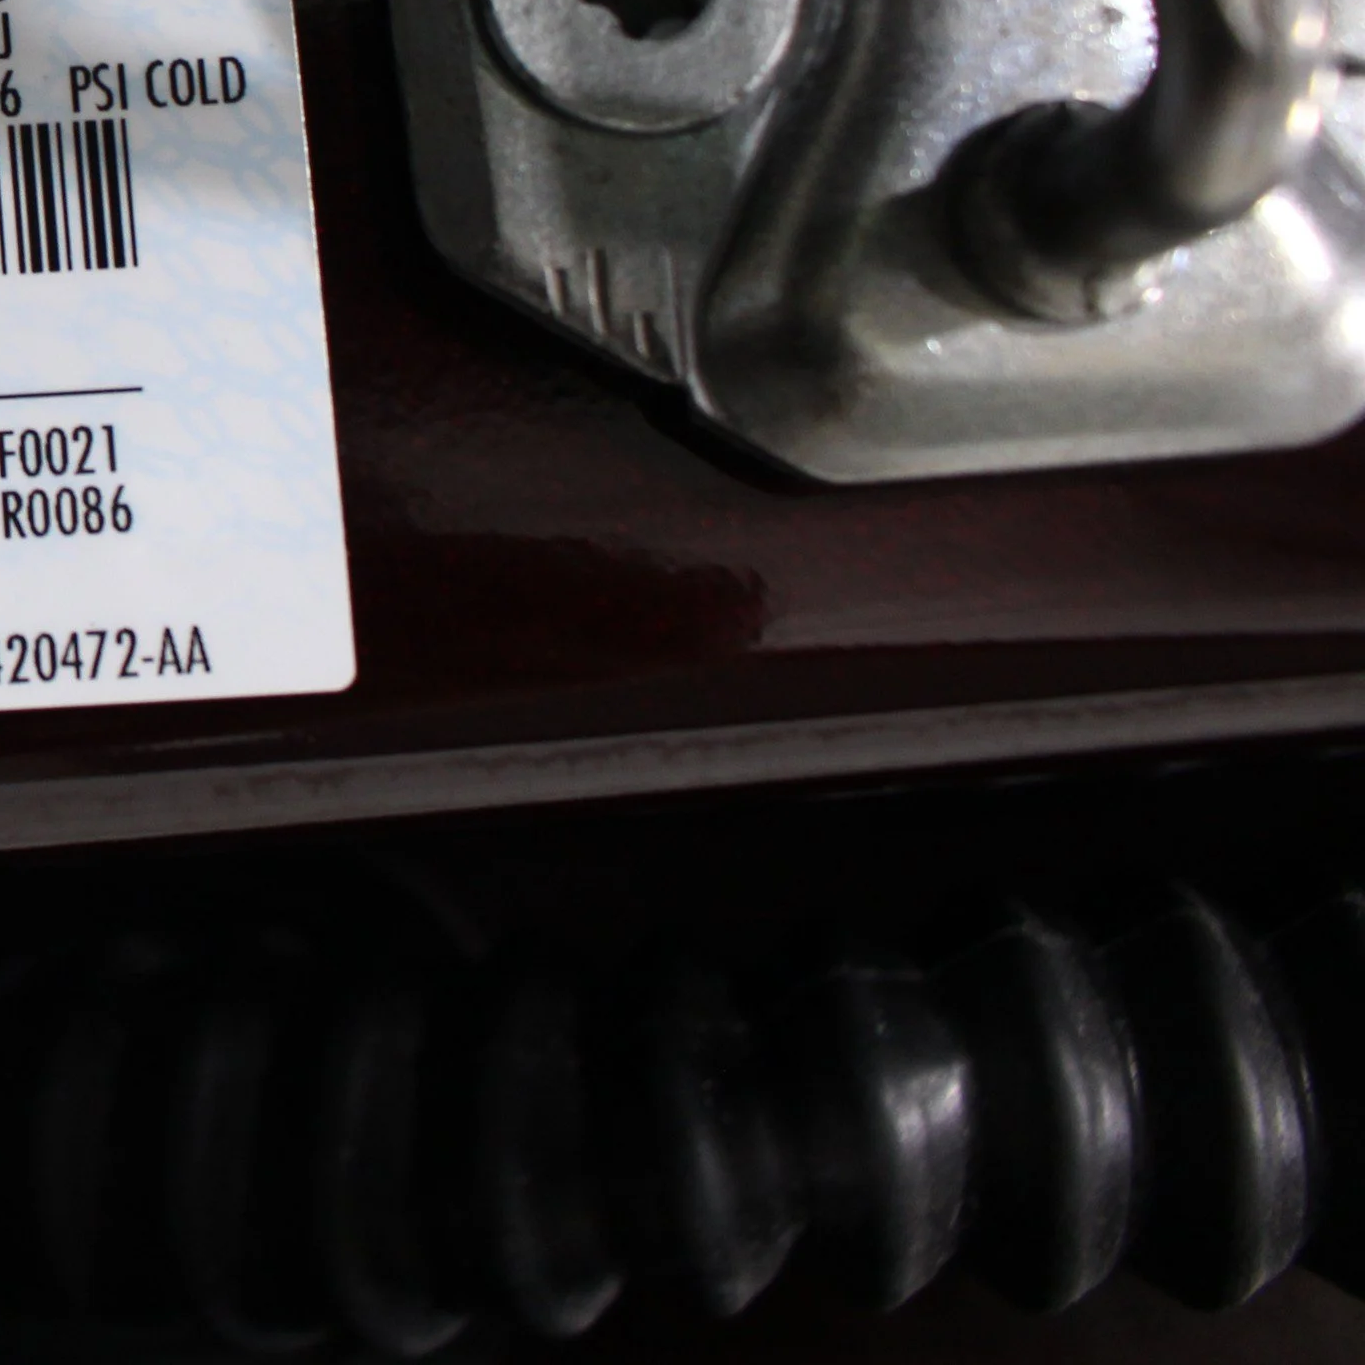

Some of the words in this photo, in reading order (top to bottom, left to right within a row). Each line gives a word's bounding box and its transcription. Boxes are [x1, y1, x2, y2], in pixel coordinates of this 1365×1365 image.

[69, 62, 128, 113] PSI
[144, 56, 246, 108] COLD
[1, 485, 132, 539] R0086
